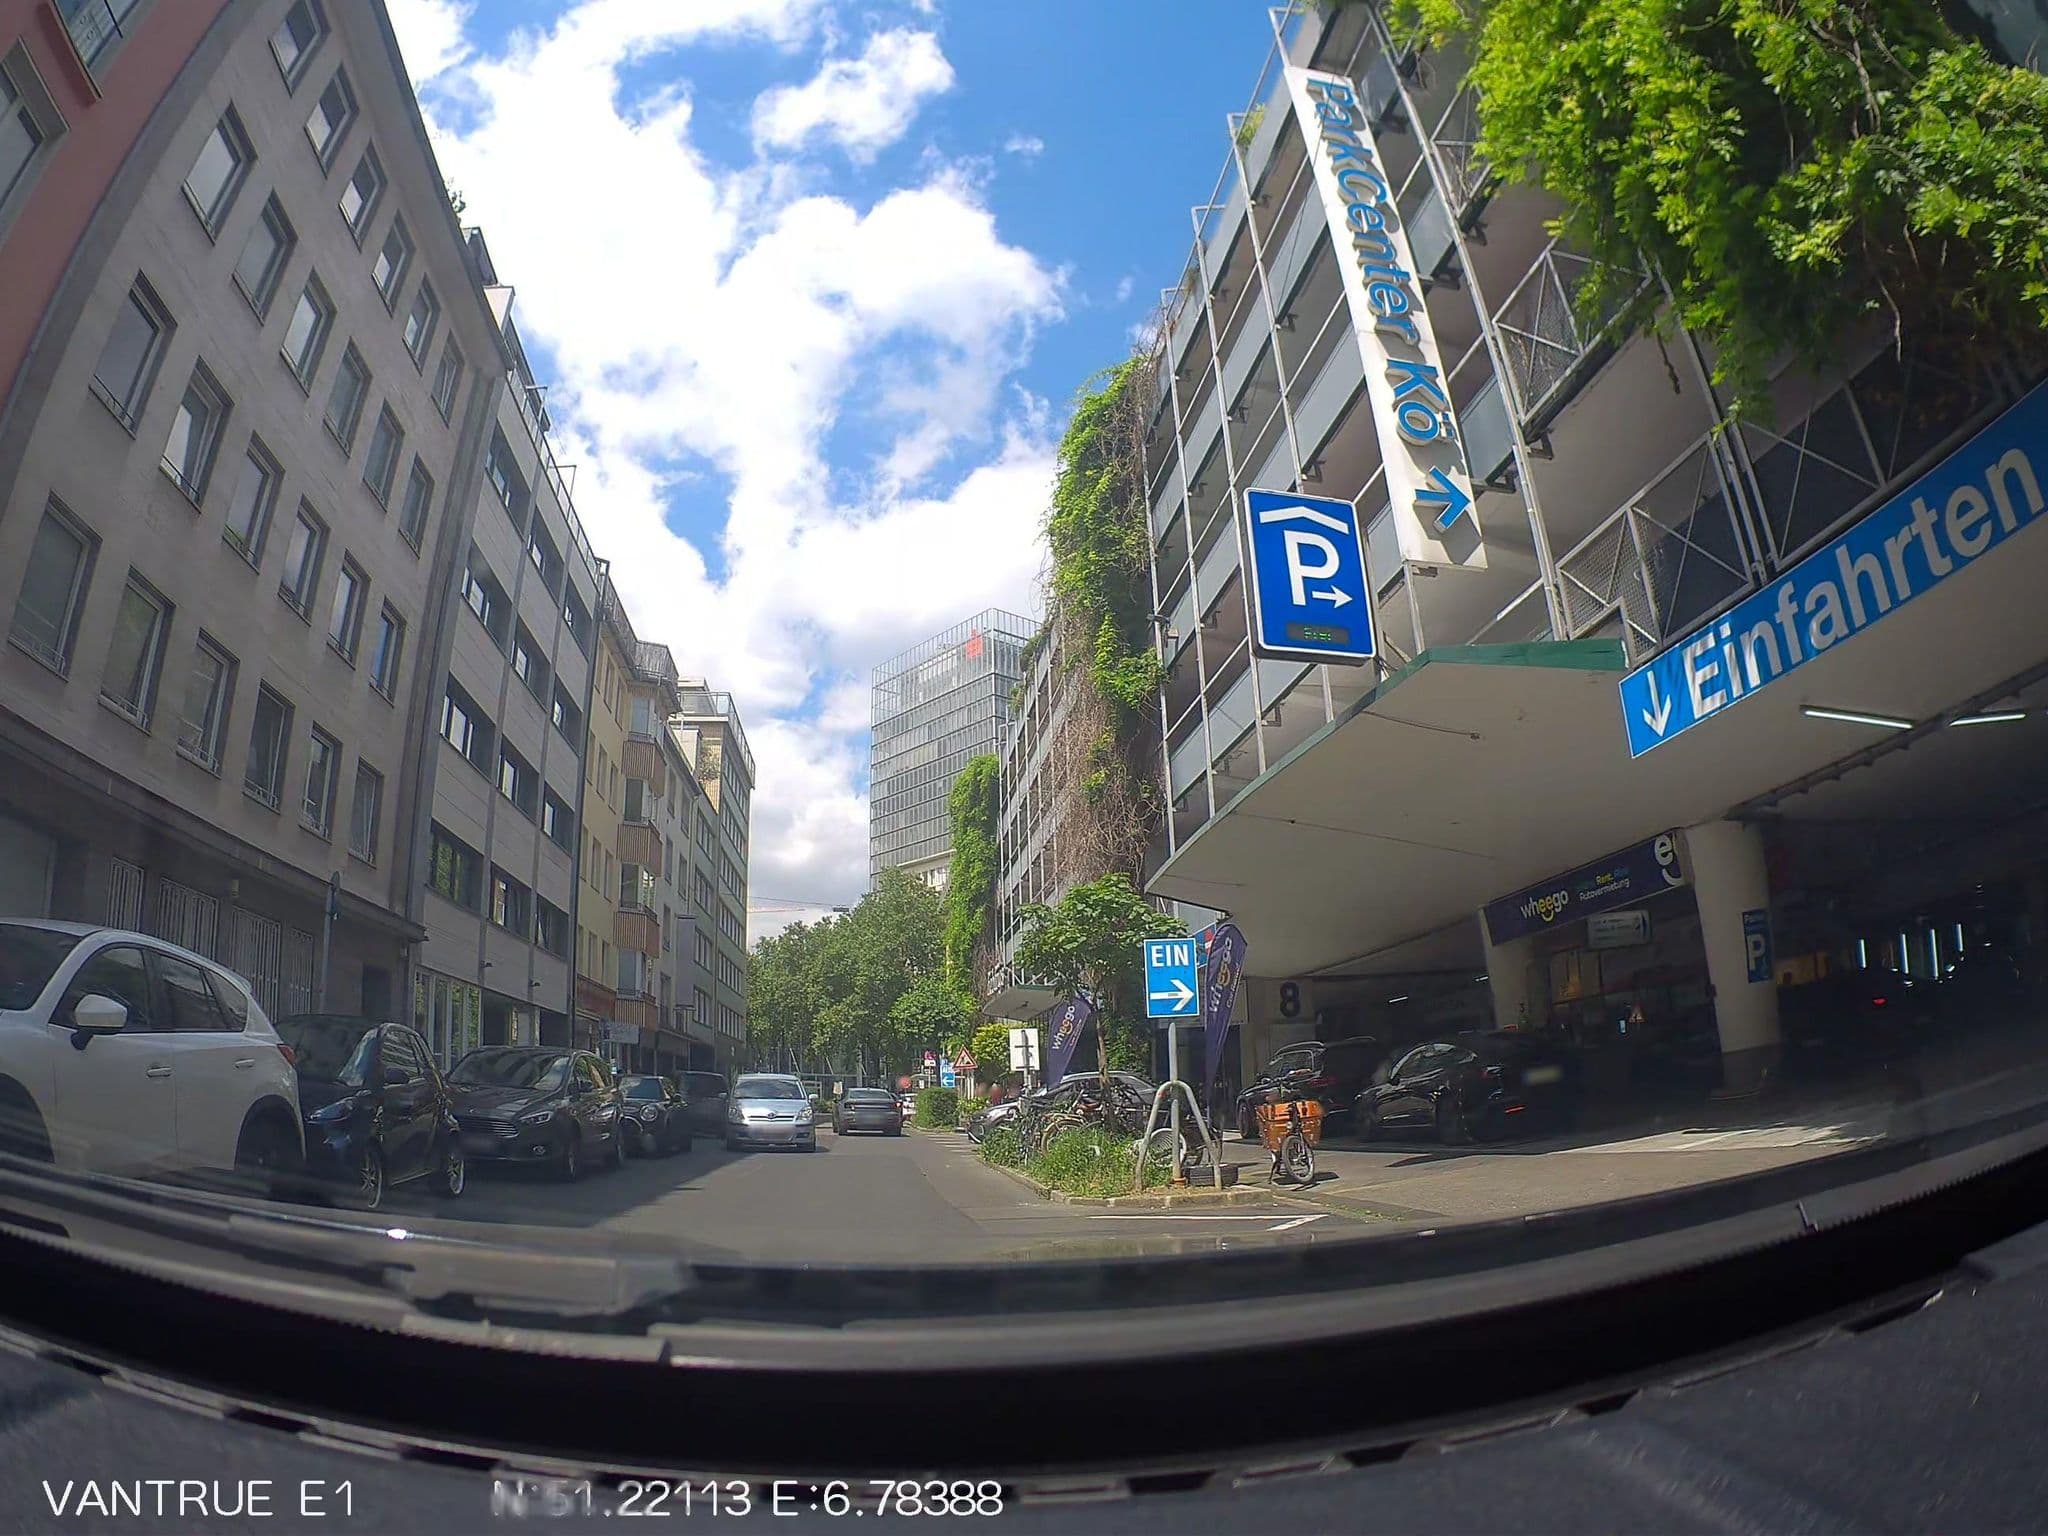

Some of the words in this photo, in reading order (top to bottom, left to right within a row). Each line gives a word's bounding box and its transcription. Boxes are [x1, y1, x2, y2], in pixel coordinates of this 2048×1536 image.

[1305, 77, 1419, 345] ParkCenter
[1387, 358, 1457, 446] Kö
[1283, 530, 1340, 606] P
[1682, 446, 2046, 719] Einfahrten
[1520, 889, 1569, 921] wheego
[1151, 944, 1189, 968] EIN
[1209, 936, 1233, 1013] wheego
[1747, 933, 1766, 971] P
[1279, 981, 1300, 1018] 8
